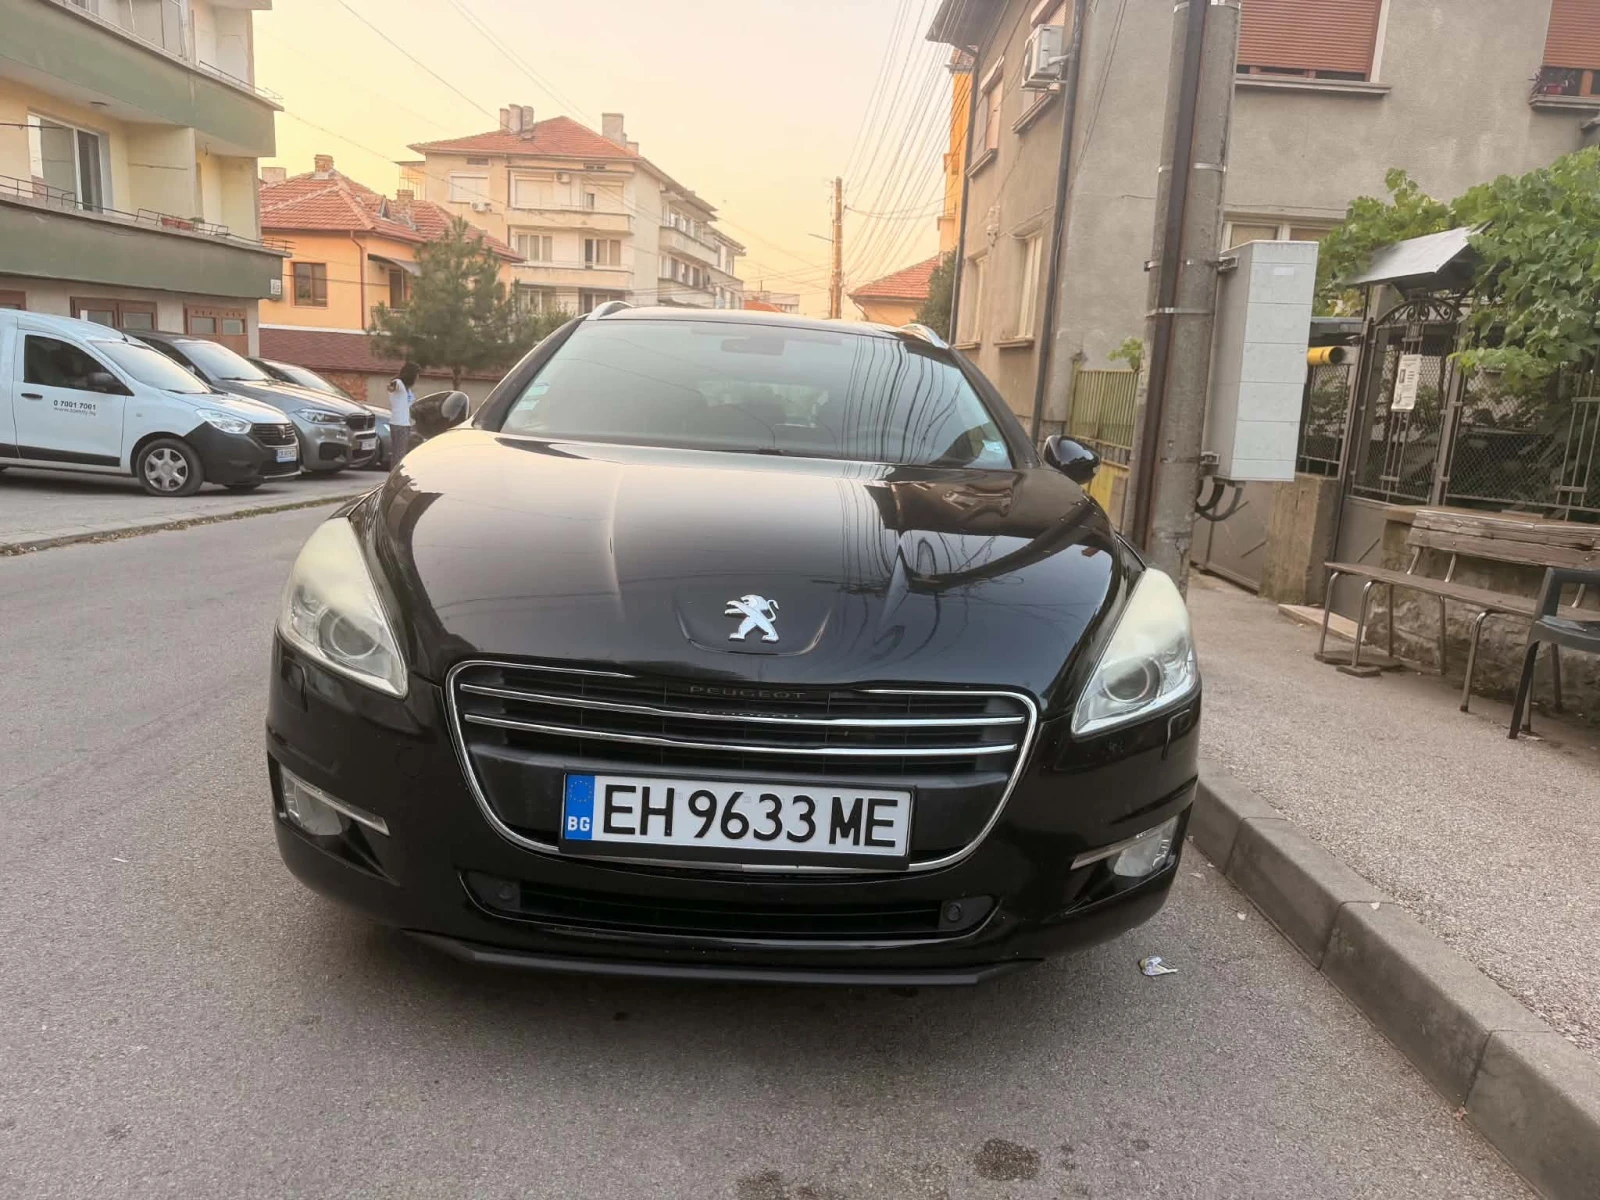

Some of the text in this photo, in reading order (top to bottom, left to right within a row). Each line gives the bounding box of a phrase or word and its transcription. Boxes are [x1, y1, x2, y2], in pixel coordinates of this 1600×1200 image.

[60, 400, 77, 408] 7001
[689, 685, 807, 699] PEUGEOT
[603, 784, 899, 847] EH 9633 ME
[567, 815, 590, 832] BG
